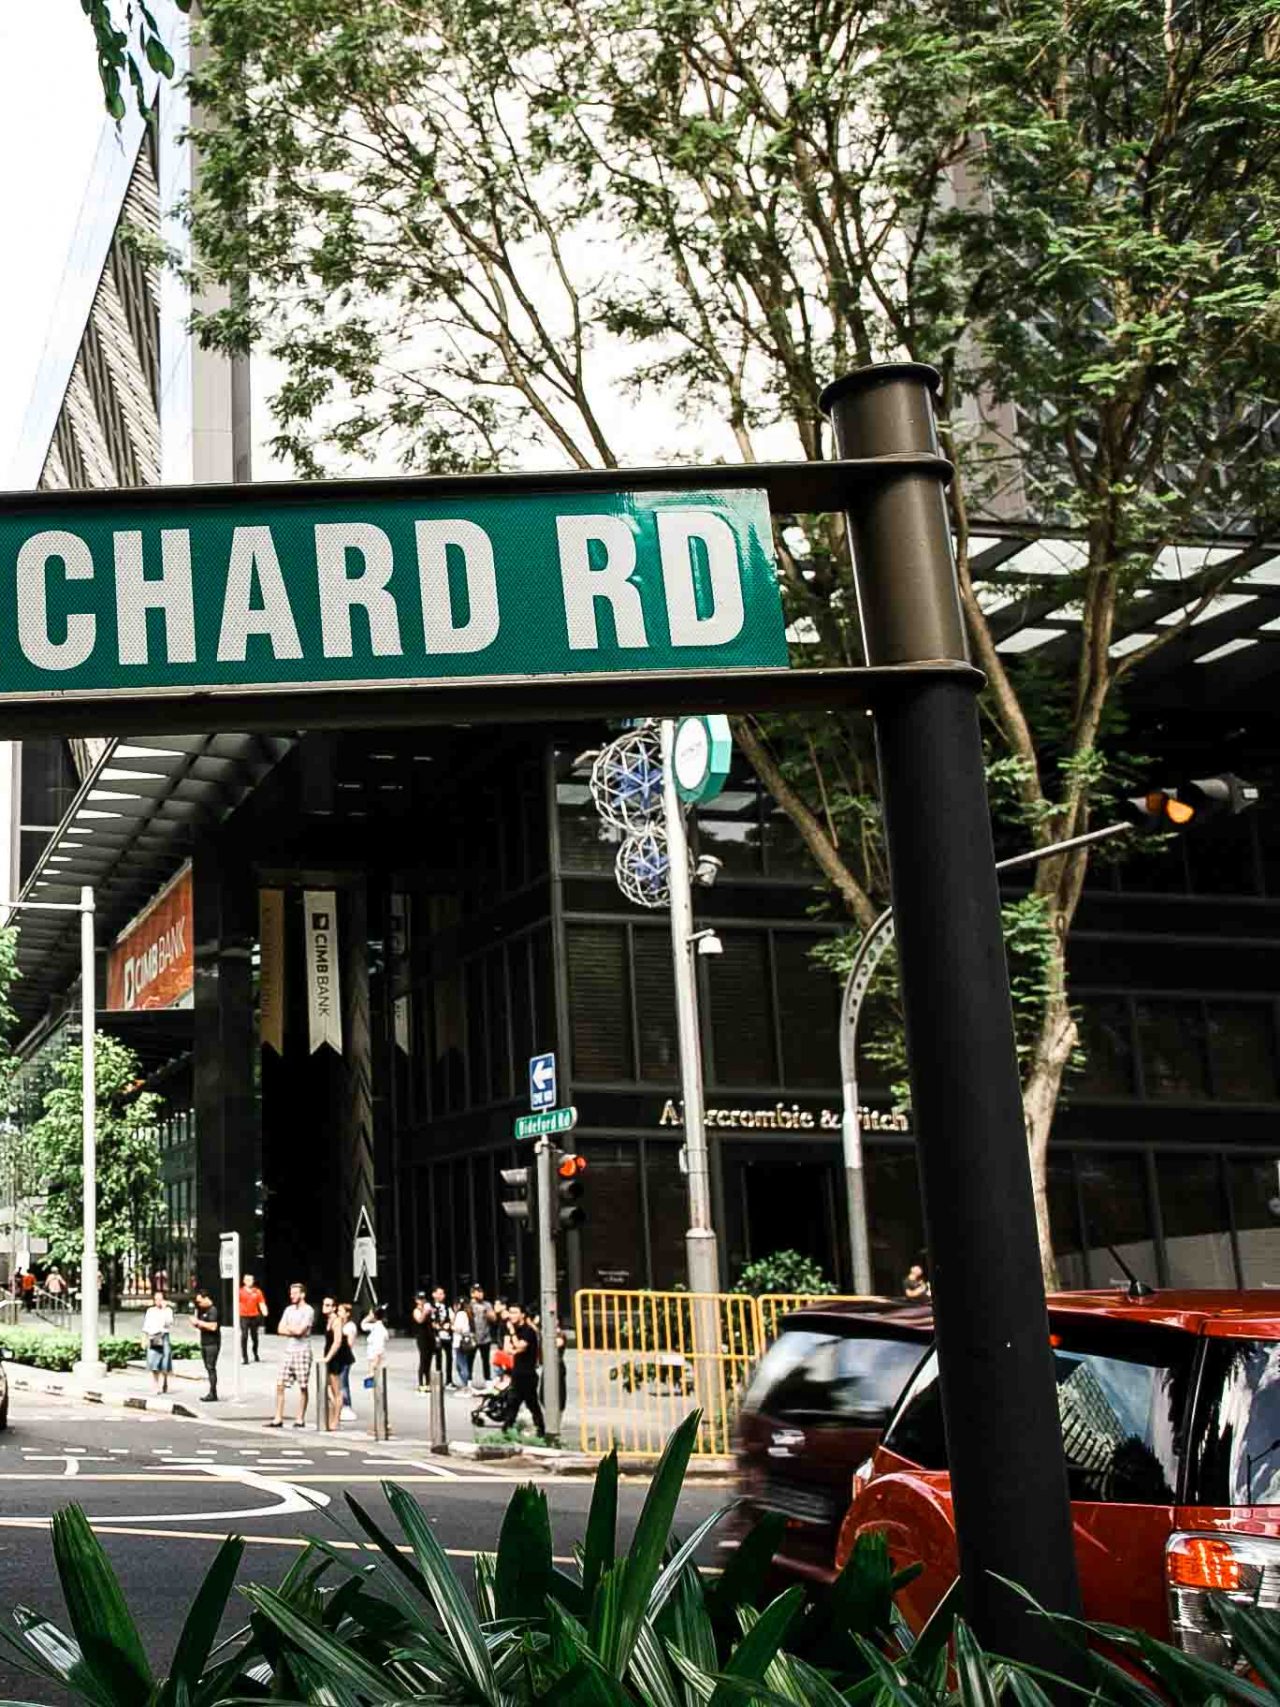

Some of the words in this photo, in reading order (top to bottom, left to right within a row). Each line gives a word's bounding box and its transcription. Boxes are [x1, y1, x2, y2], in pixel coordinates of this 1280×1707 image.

[556, 511, 747, 650] RD
[134, 942, 158, 994] CIMB
[159, 915, 186, 974] BANK
[314, 932, 329, 973] CIMB
[316, 975, 330, 1017] BANK
[558, 1111, 570, 1128] Rd
[659, 1099, 815, 1130] Arcrombie
